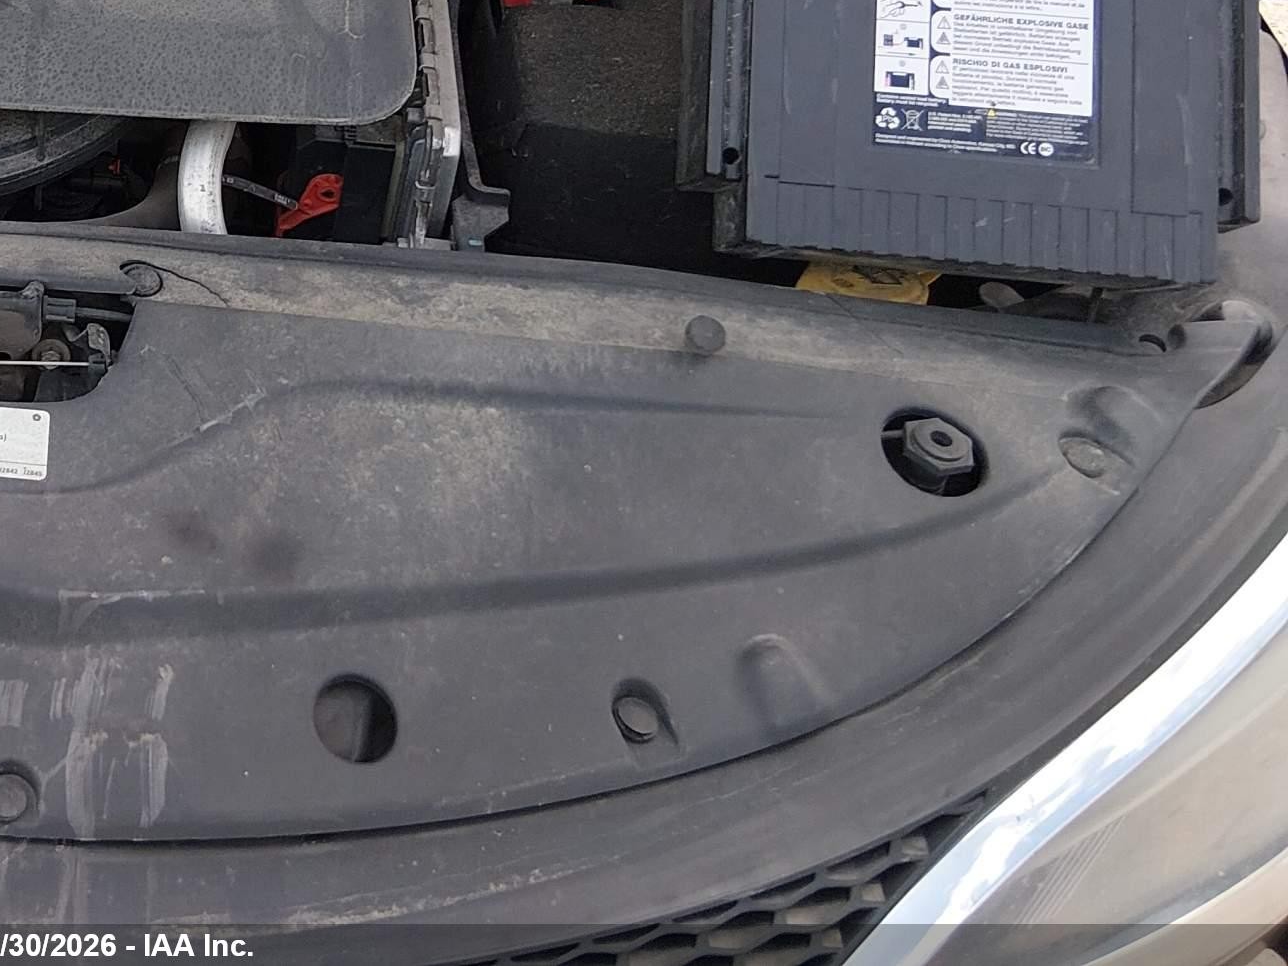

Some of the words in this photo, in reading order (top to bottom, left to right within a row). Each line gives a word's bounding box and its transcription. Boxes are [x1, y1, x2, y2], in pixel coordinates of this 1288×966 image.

[1016, 18, 1064, 29] EXPLOSIVE
[1066, 22, 1089, 31] GASE
[952, 57, 989, 68] RISCHIO
[1003, 62, 1021, 70] GAS
[1023, 63, 1068, 73] ESPLOSIVI
